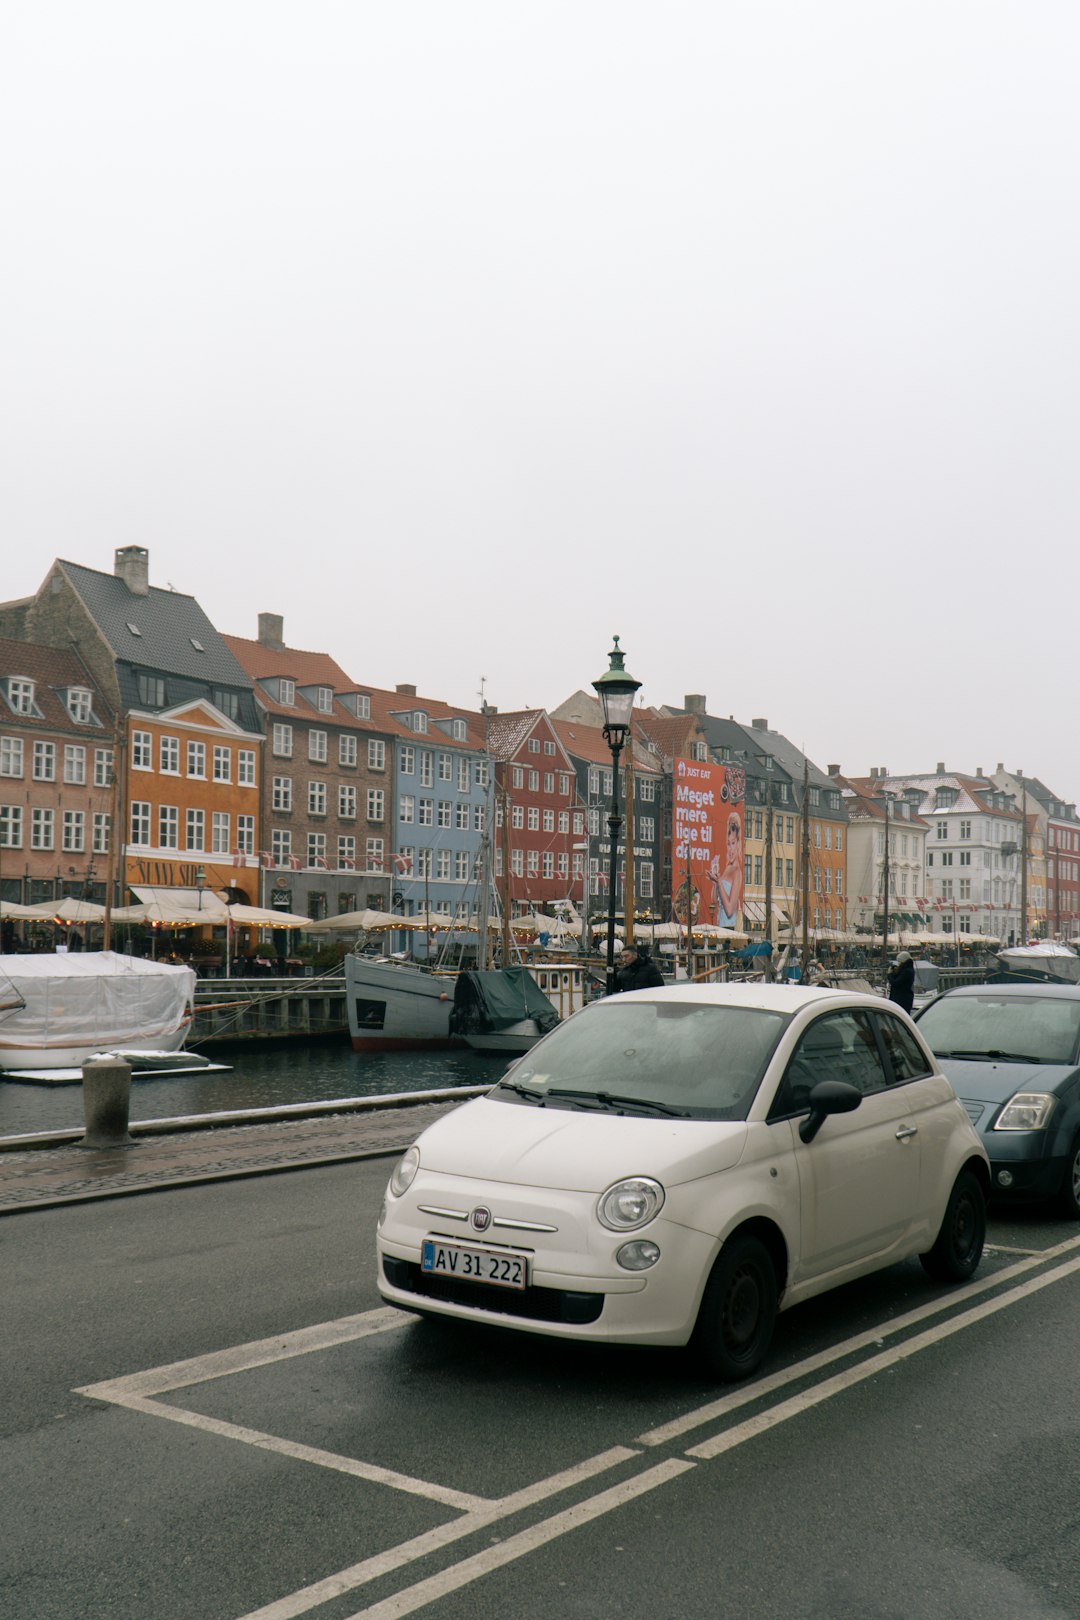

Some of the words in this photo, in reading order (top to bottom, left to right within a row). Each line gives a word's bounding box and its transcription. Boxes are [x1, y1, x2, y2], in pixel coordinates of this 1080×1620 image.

[686, 767, 700, 777] JUST
[701, 769, 711, 779] EAT
[676, 784, 715, 808] Meget
[675, 807, 708, 823] mere
[675, 822, 698, 844] lige
[700, 825, 713, 843] til
[598, 843, 653, 857] HAFUEN
[179, 863, 199, 887] SID
[424, 1258, 432, 1267] DK
[435, 1249, 459, 1272] AV
[462, 1253, 482, 1277] 31
[489, 1258, 522, 1284] 222
